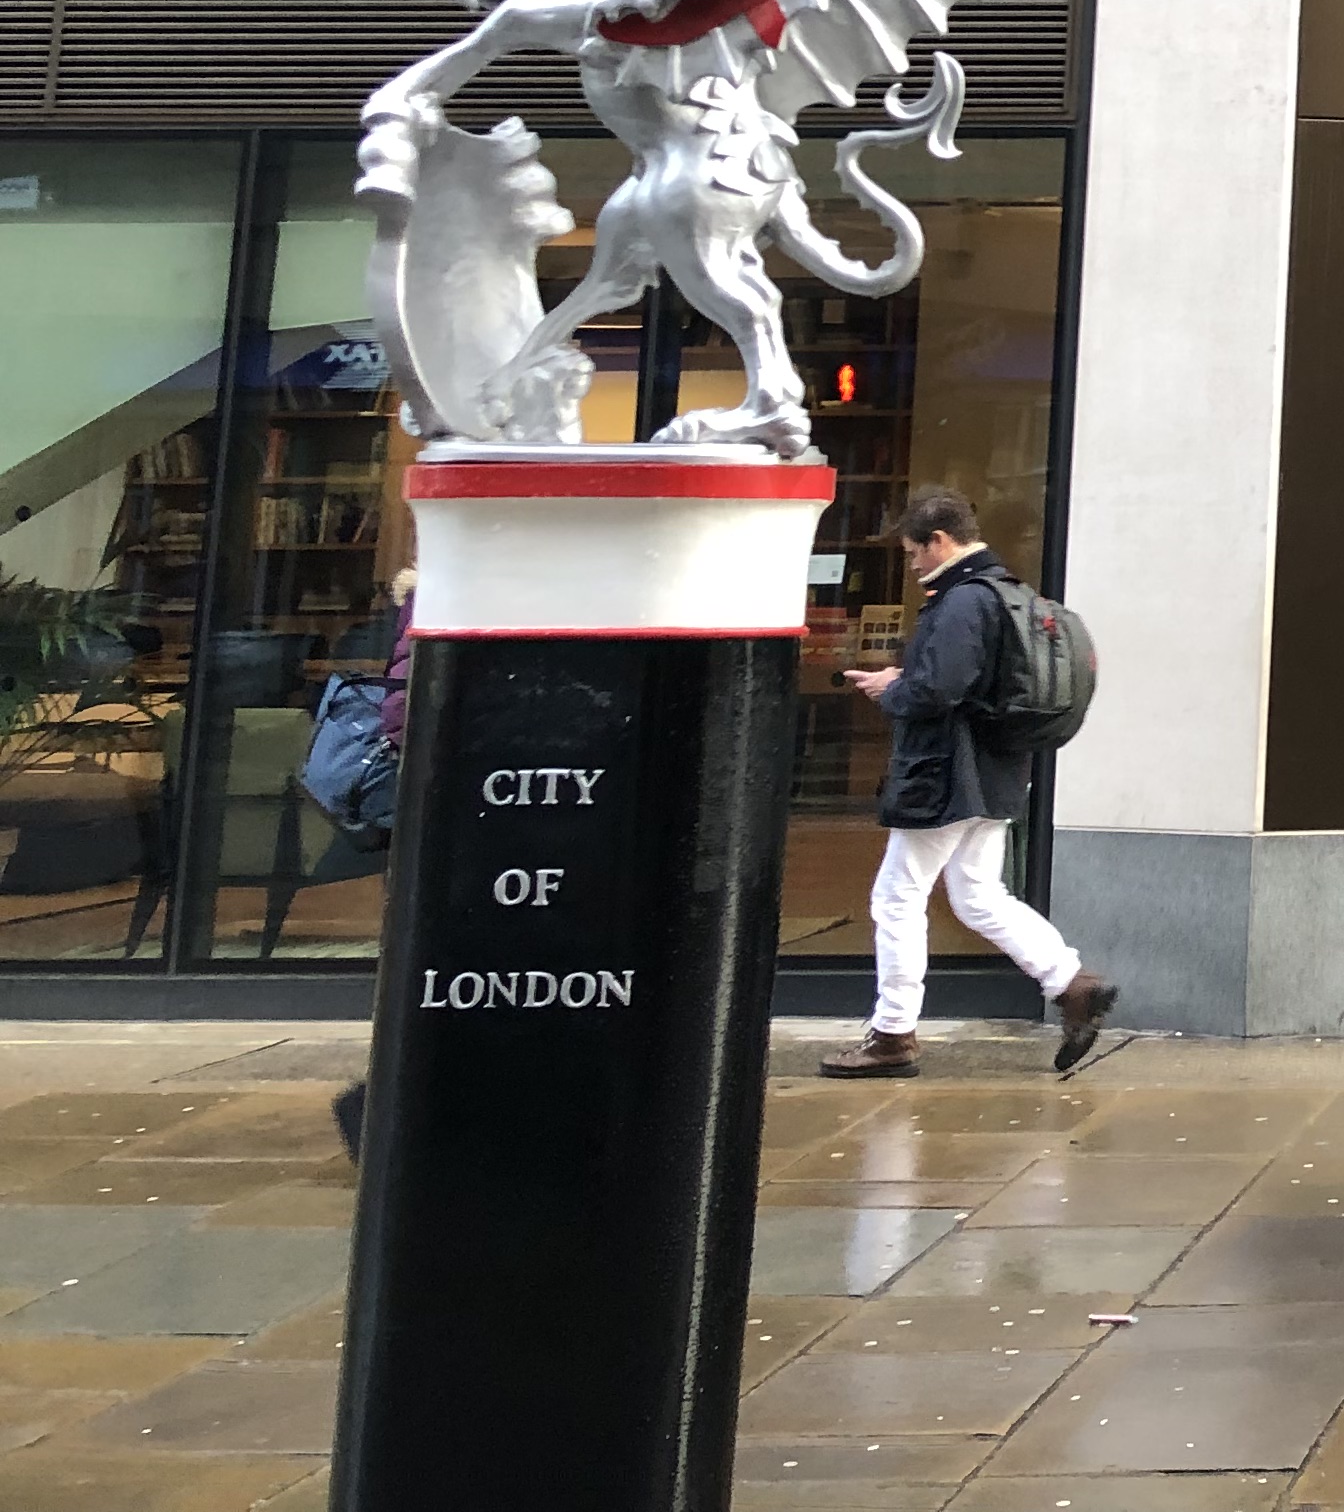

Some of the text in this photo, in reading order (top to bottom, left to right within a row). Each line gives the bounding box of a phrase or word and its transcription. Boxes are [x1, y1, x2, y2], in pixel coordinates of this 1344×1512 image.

[483, 768, 605, 805] CITY
[494, 868, 564, 906] OF
[420, 969, 635, 1009] LONDON
